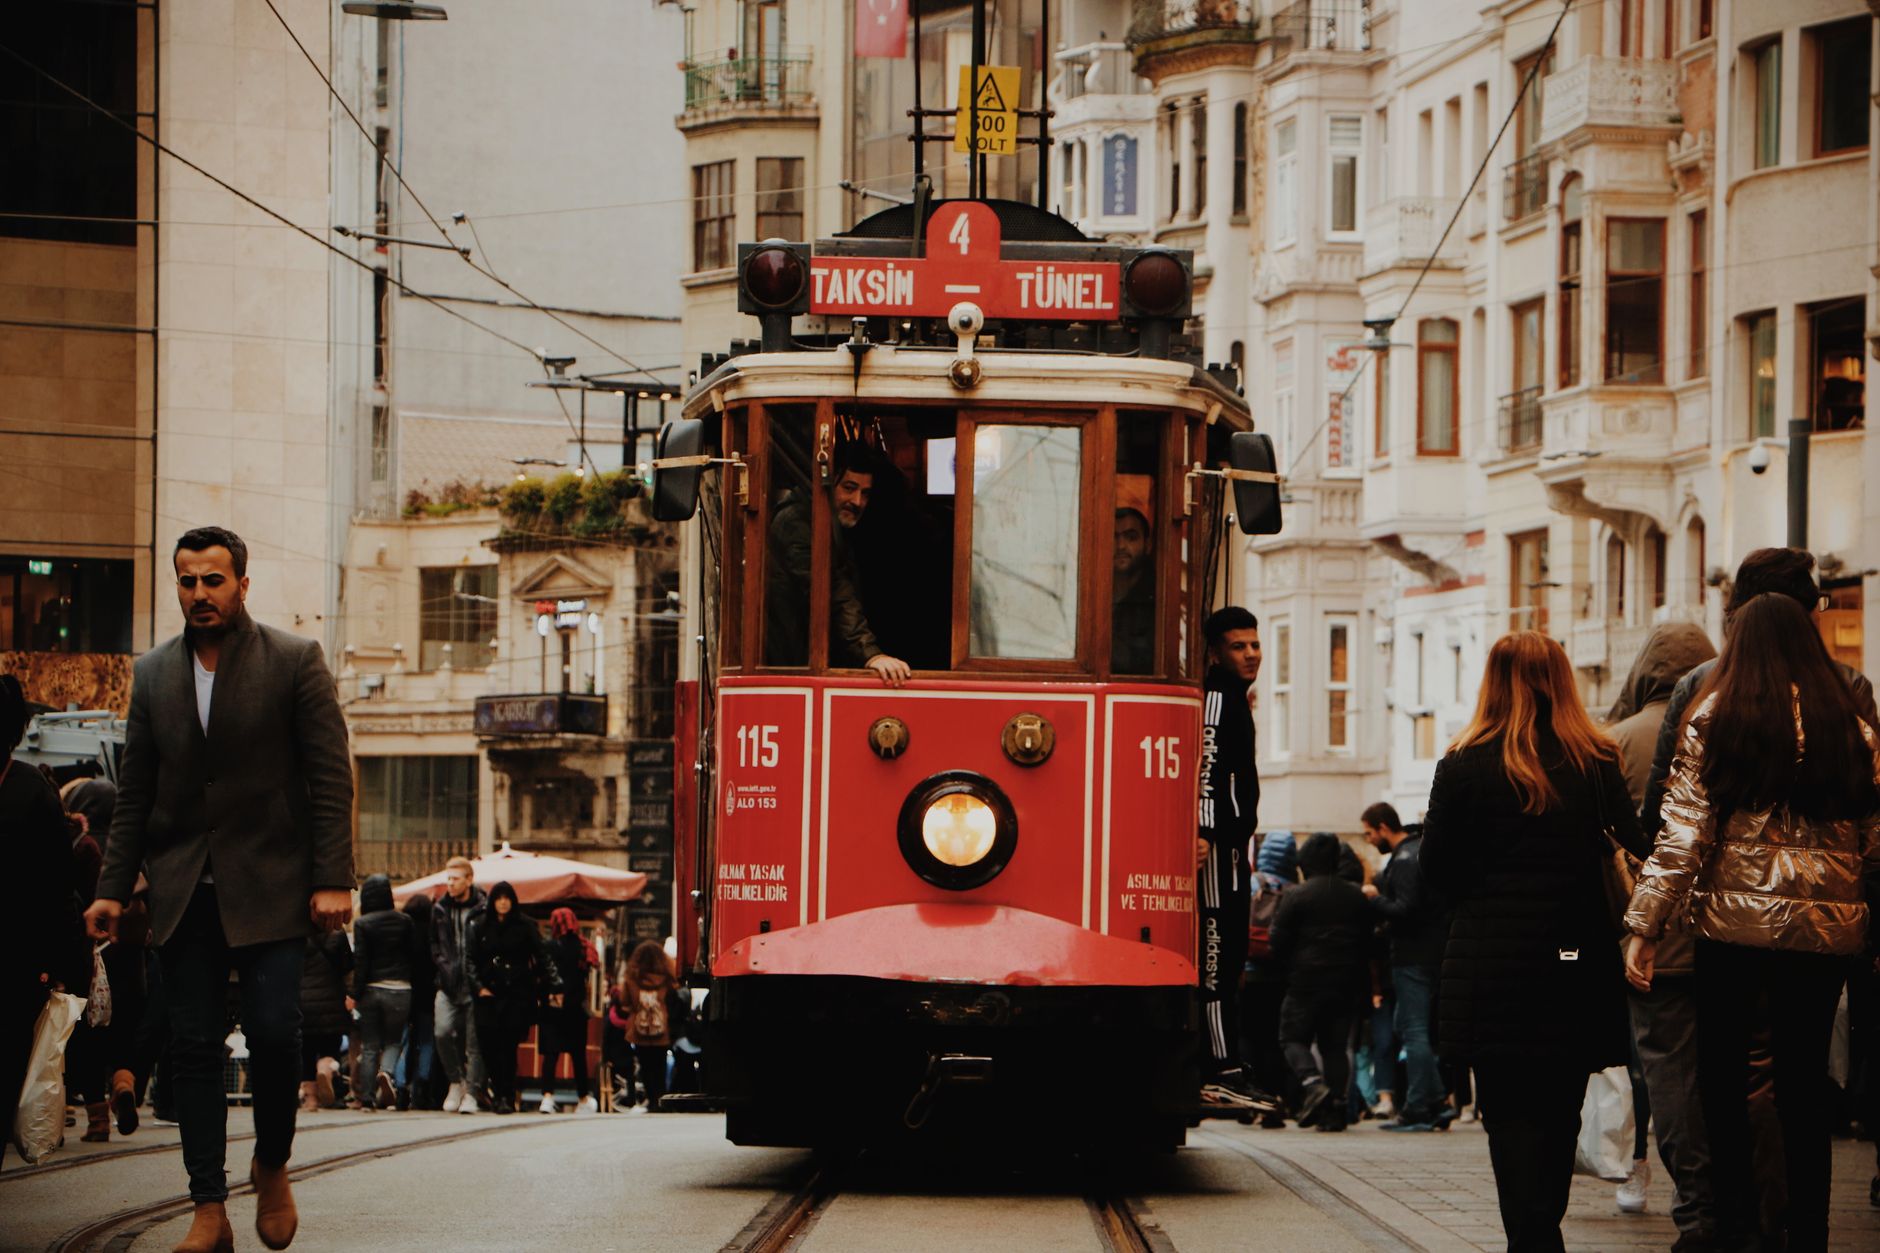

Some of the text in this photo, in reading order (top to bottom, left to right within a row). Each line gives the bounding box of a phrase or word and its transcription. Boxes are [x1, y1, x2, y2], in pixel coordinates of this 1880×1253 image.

[949, 213, 970, 255] 4
[810, 263, 1113, 310] TAKSİM TÜNEL
[737, 725, 779, 768] 115
[1139, 735, 1180, 779] 115
[1202, 726, 1219, 780] adidas
[737, 798, 777, 809] ALO 153
[724, 882, 788, 902] TEHLİKELİDİR
[749, 864, 785, 881] YASAK
[1126, 873, 1172, 890] ASILMAK
[1120, 894, 1137, 910] VE
[1205, 916, 1222, 972] adidas
